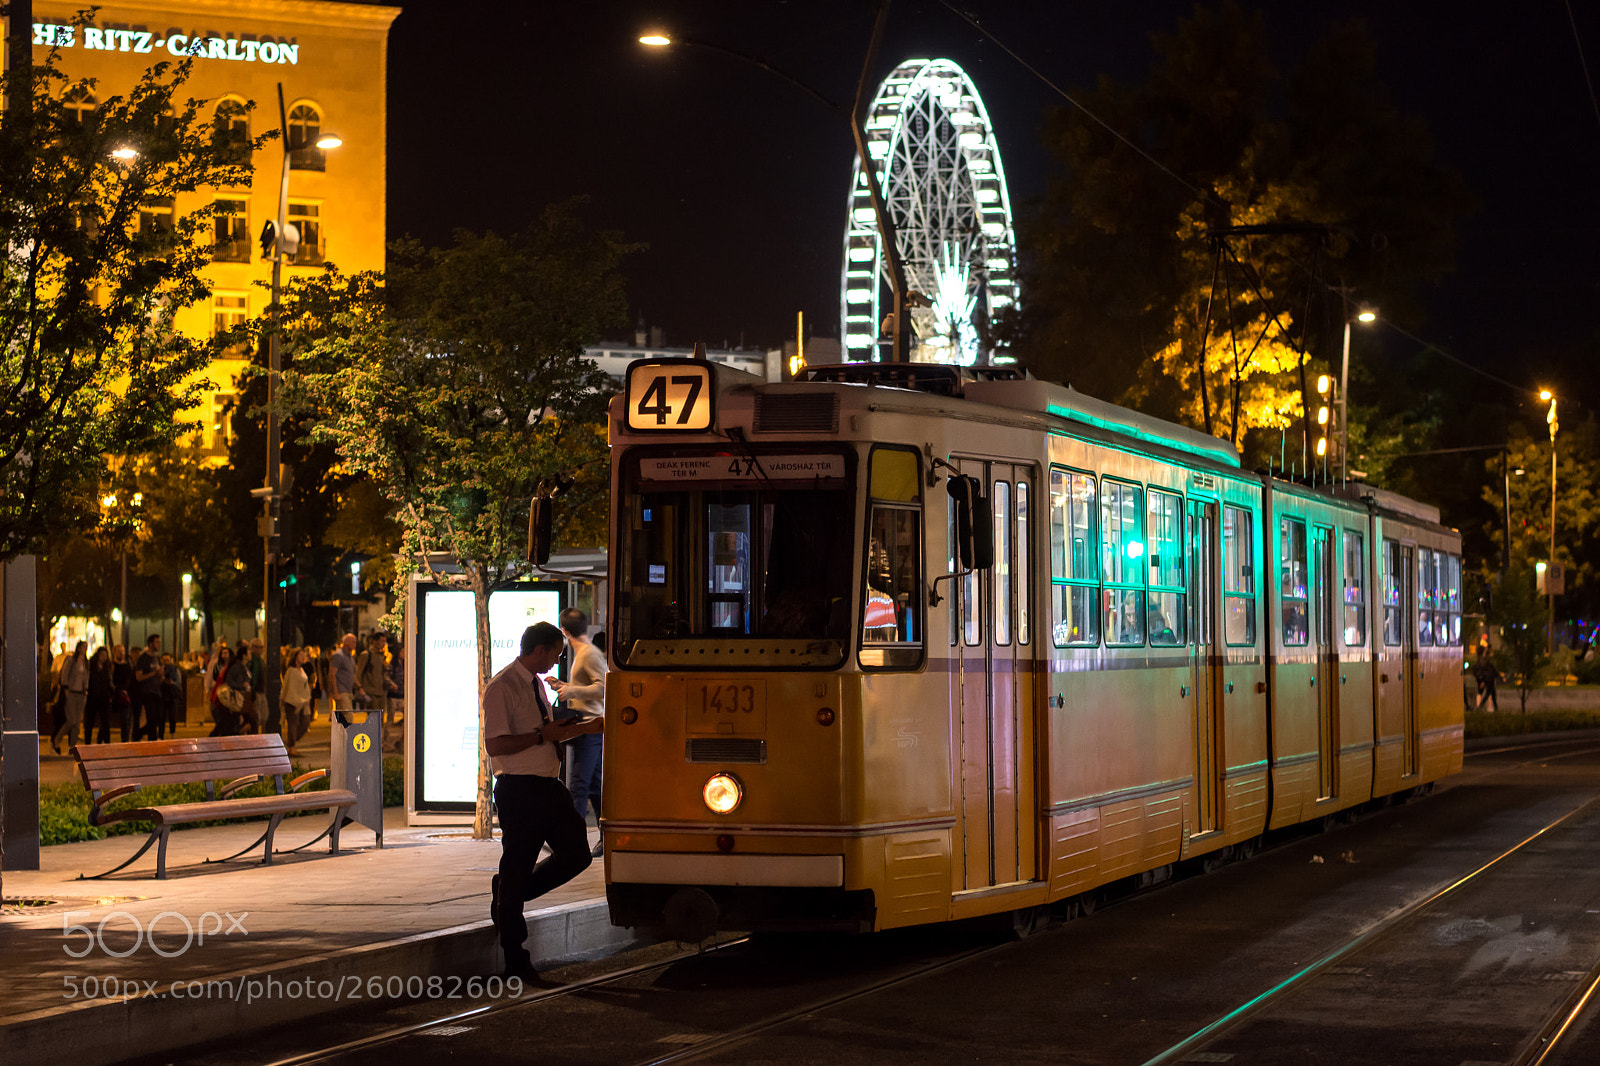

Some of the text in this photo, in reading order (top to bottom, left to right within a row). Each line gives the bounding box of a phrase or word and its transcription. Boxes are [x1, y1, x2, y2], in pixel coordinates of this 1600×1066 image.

[31, 23, 299, 65] HE RITZ-CARLTON
[638, 375, 703, 425] 47
[671, 469, 687, 477] TÉR
[680, 461, 711, 469] FERENC
[728, 458, 754, 476] 47
[769, 462, 832, 471] VÁROSHÁZ TÉR
[701, 685, 754, 713] 1433
